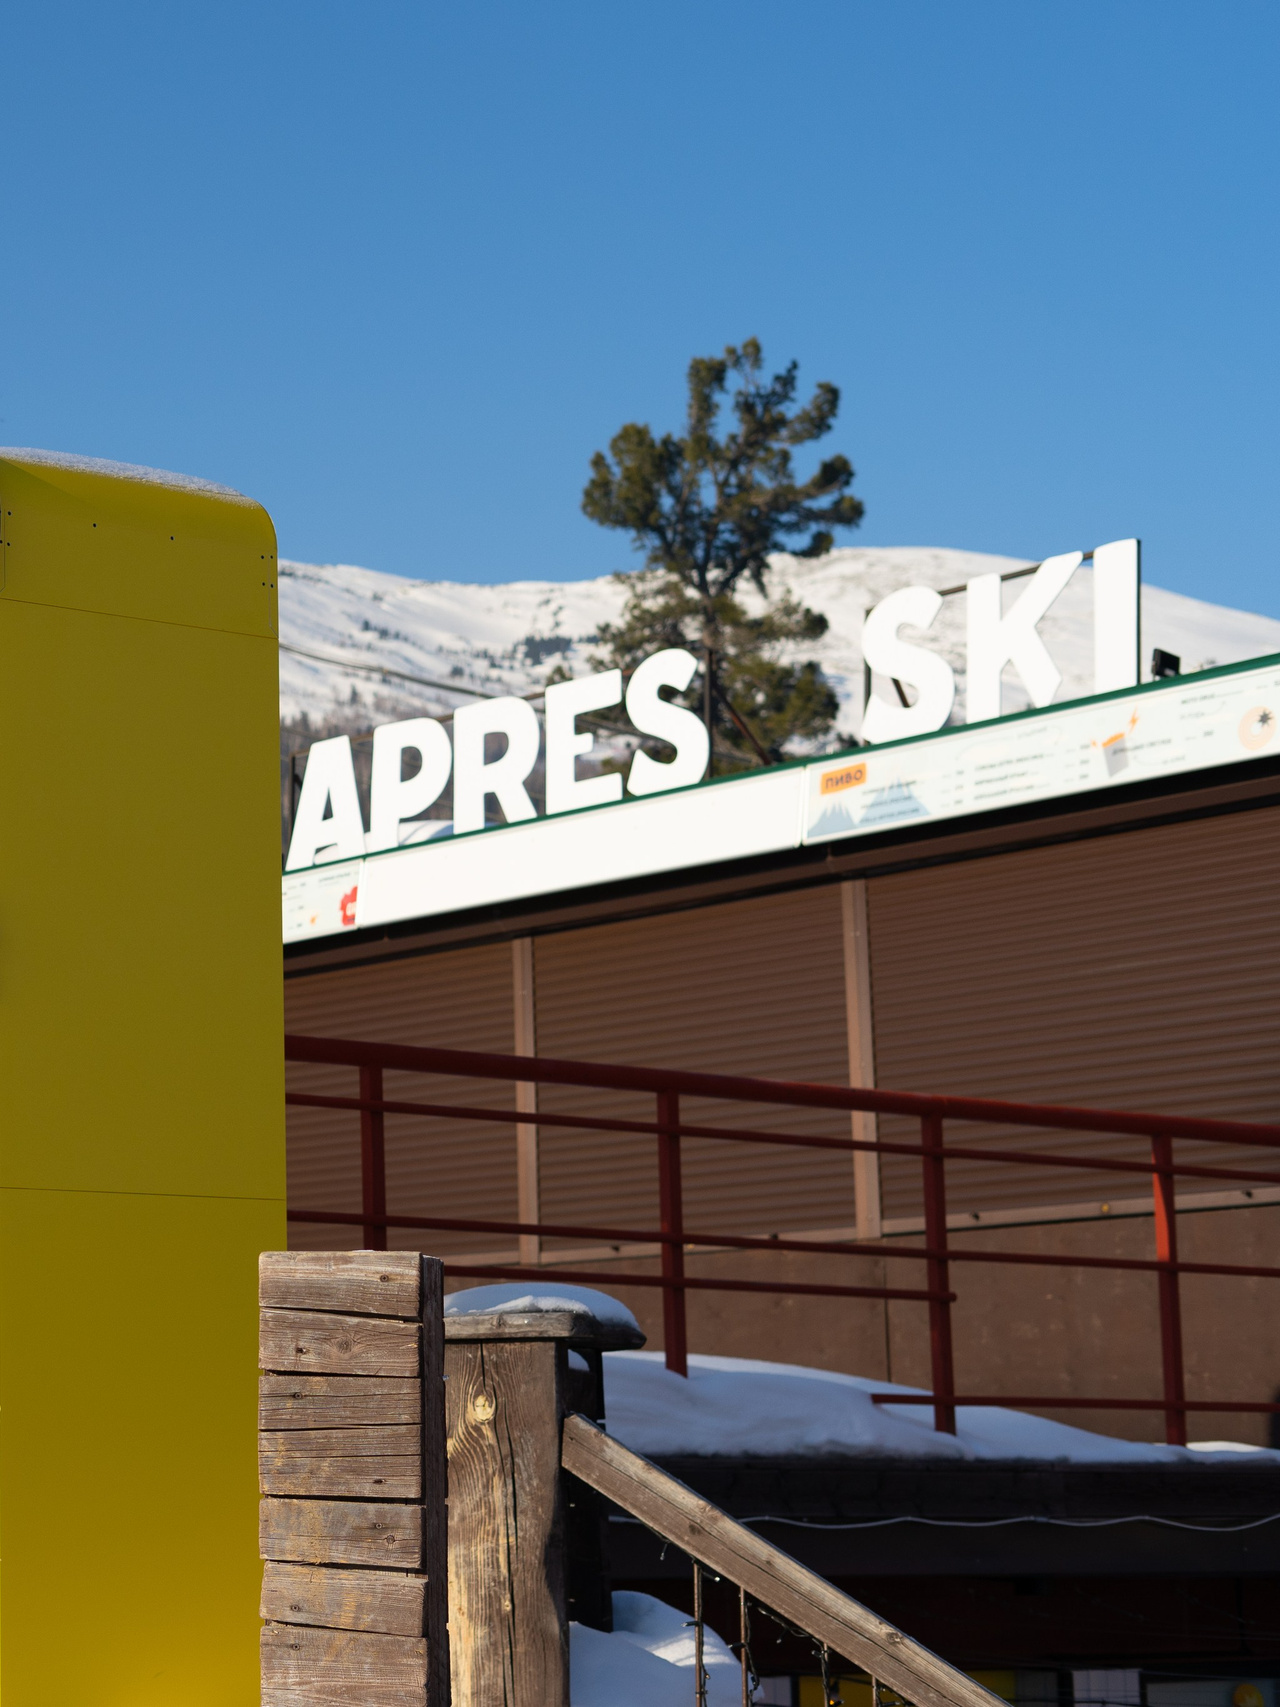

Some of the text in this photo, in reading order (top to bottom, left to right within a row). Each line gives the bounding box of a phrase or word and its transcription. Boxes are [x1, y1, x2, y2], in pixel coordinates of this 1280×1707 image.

[284, 538, 1140, 873] APRES SKI
[825, 769, 864, 789] ПИВО
